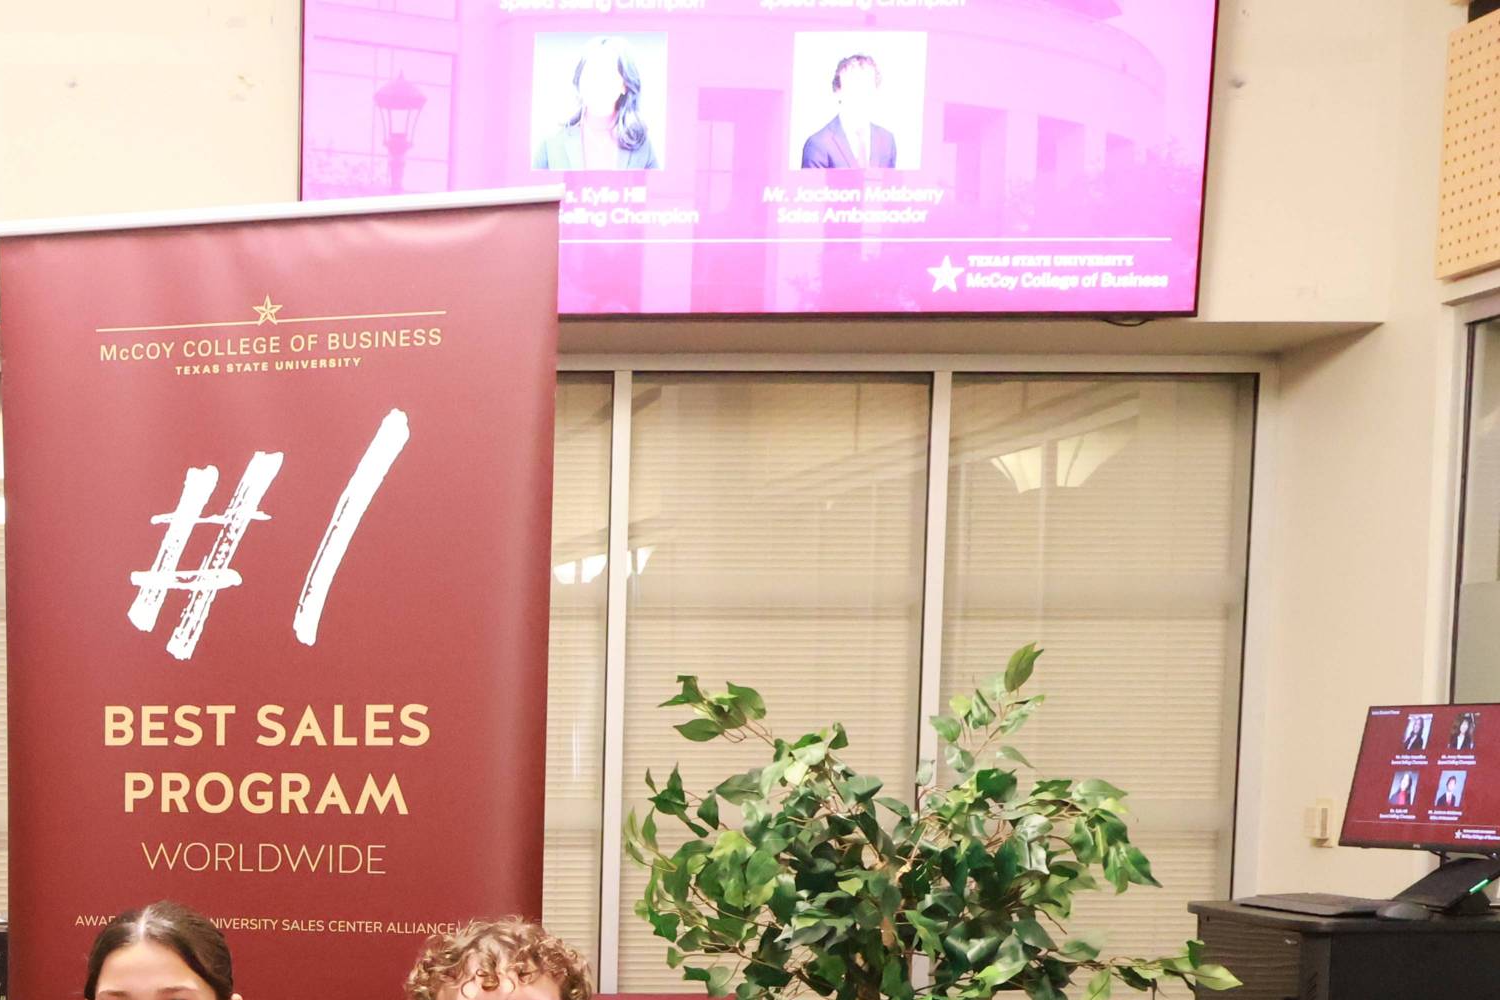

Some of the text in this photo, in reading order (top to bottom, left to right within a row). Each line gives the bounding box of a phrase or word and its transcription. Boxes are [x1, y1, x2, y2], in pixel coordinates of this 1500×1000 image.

[582, 187, 620, 205] Kylie
[624, 187, 647, 203] Hill
[764, 186, 788, 202] Mr.
[795, 186, 860, 202] Jackson
[611, 208, 700, 227] Champion
[778, 207, 928, 223] Sales Ambassador
[968, 255, 1134, 267] TEXAS STATE UNIVERSITY
[966, 272, 1169, 291] McCoy College of Business
[100, 328, 443, 361] McCOY COLLEGE OF BUSINESS
[176, 357, 362, 376] TEXAS STATE UNIVERSITY
[127, 407, 410, 660] #1
[104, 704, 431, 747] BEST SALES
[124, 772, 408, 815] PROGRAM
[142, 842, 386, 875] WORLDWIDE
[282, 920, 325, 932] SALES
[329, 921, 382, 933] CENTER
[387, 922, 458, 936] ALLIANCE
